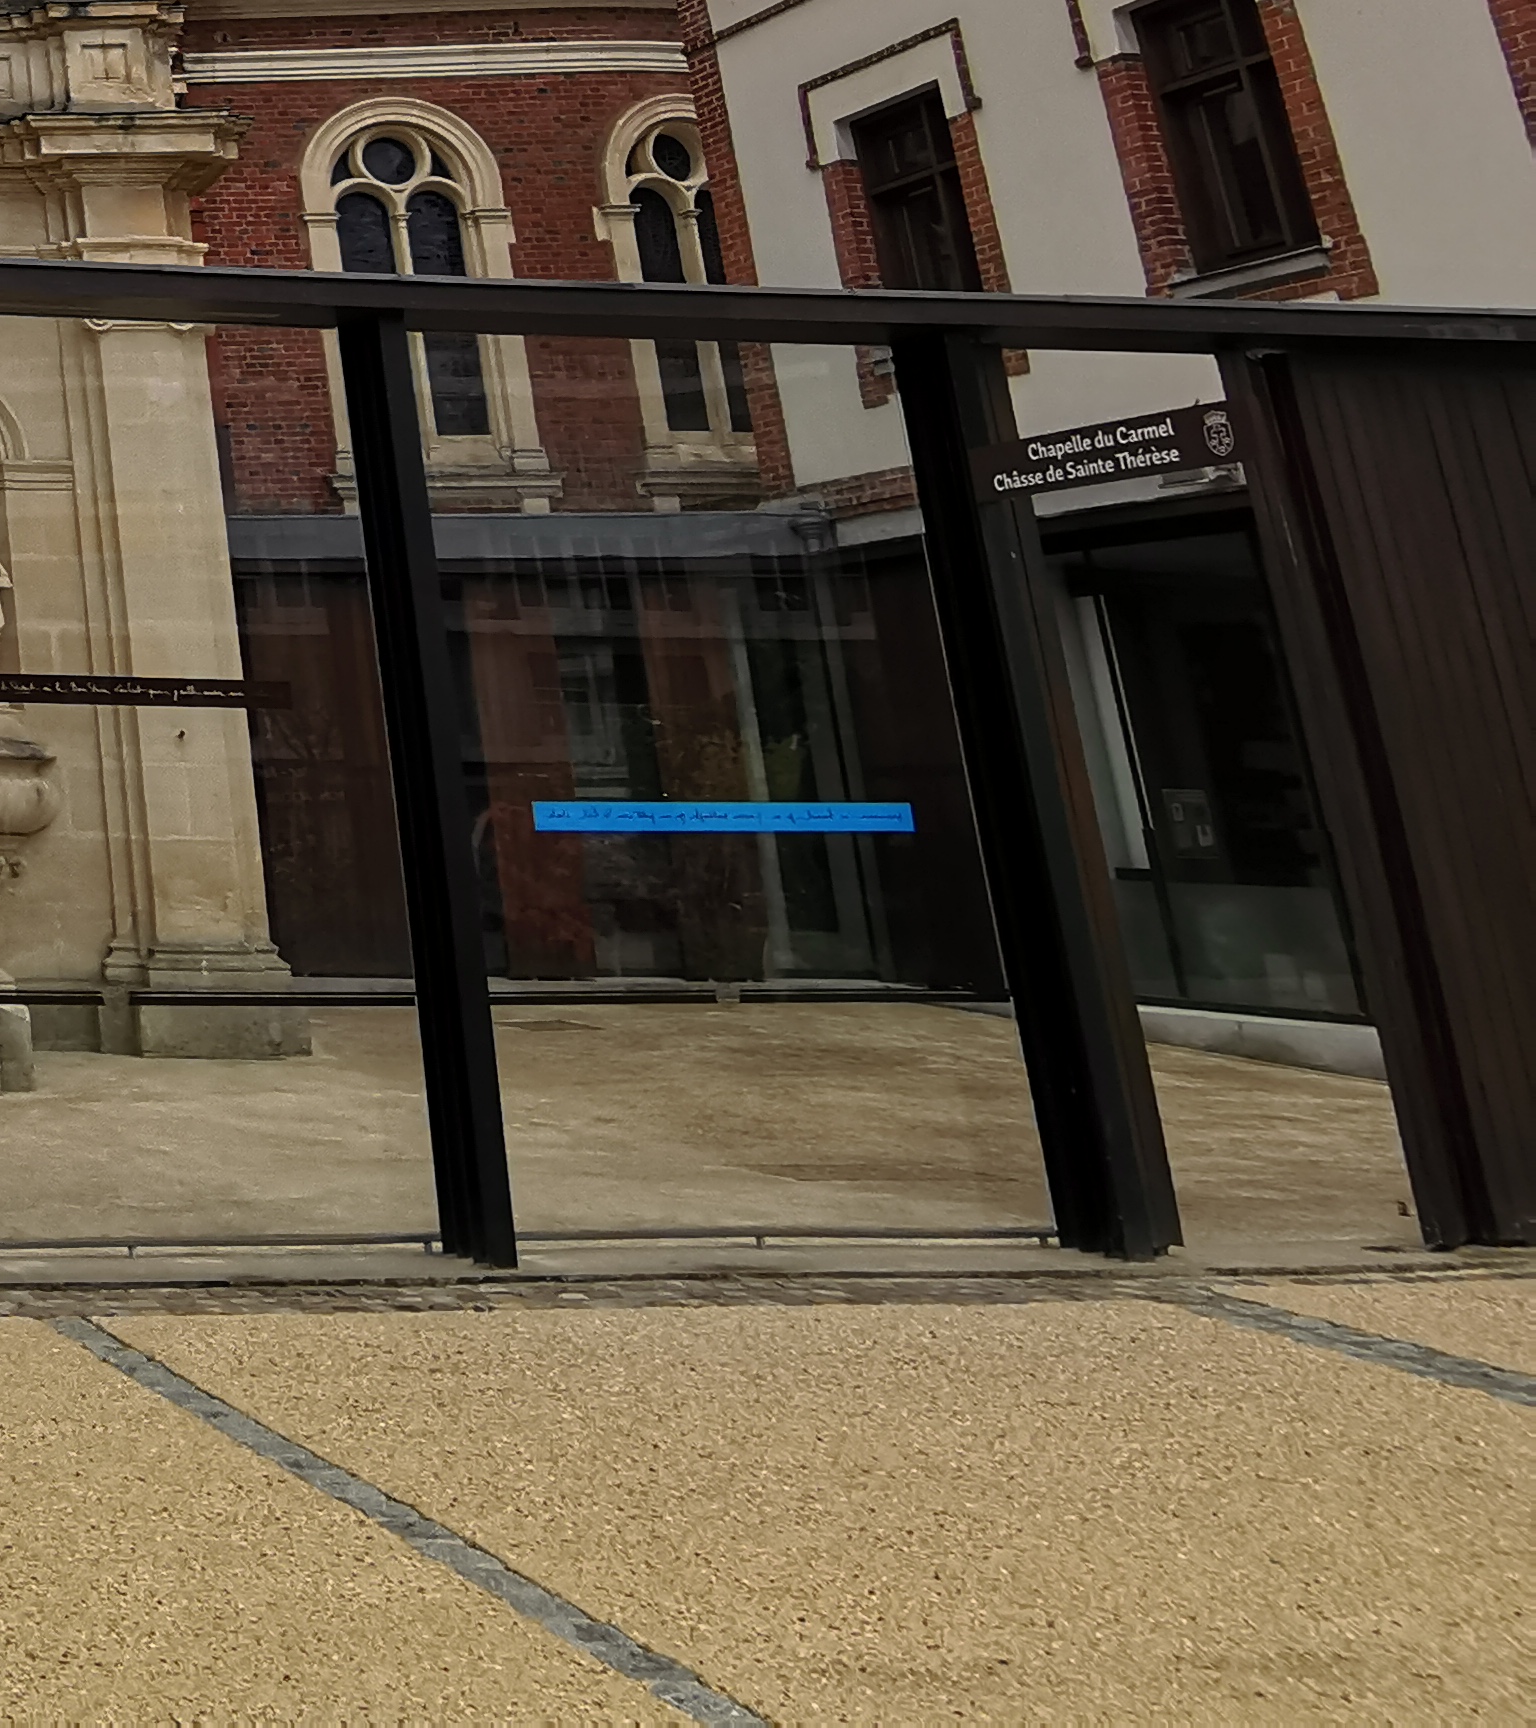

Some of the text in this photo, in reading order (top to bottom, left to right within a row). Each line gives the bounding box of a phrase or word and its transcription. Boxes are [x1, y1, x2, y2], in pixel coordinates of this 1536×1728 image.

[1028, 417, 1176, 461] Chapelle du Carmel
[993, 446, 1181, 491] Châsse de Sainte Thérèse
